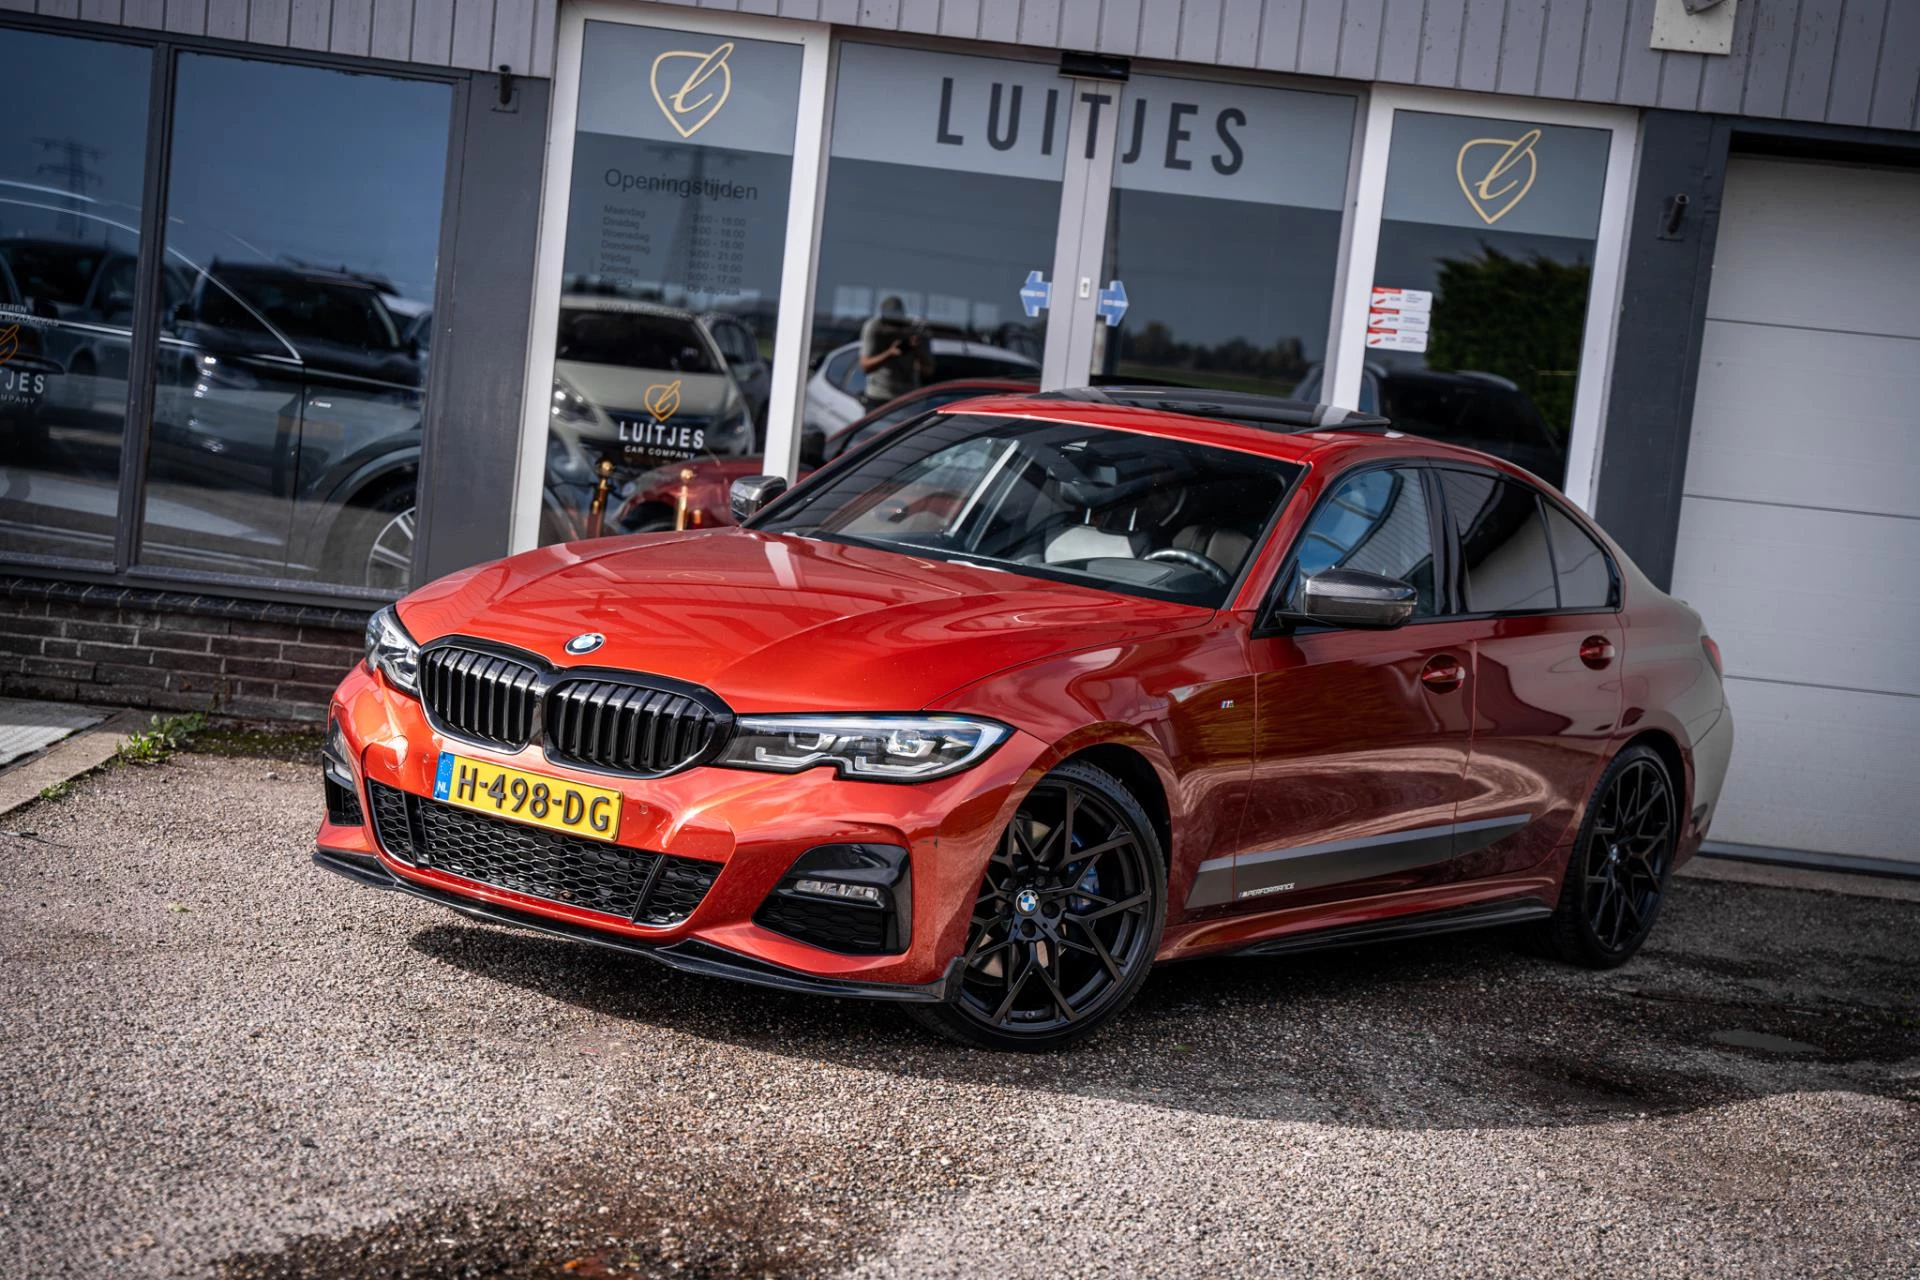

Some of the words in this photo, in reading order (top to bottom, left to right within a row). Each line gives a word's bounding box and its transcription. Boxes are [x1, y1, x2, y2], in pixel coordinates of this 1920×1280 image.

[936, 77, 1248, 176] LUITJES
[604, 168, 758, 201] Openingstijden
[0, 370, 45, 394] JES
[618, 421, 705, 449] LUITJES
[624, 445, 645, 455] CAR
[648, 447, 696, 461] COMPANY
[437, 780, 448, 793] NL
[457, 764, 610, 832] H-498-DG
